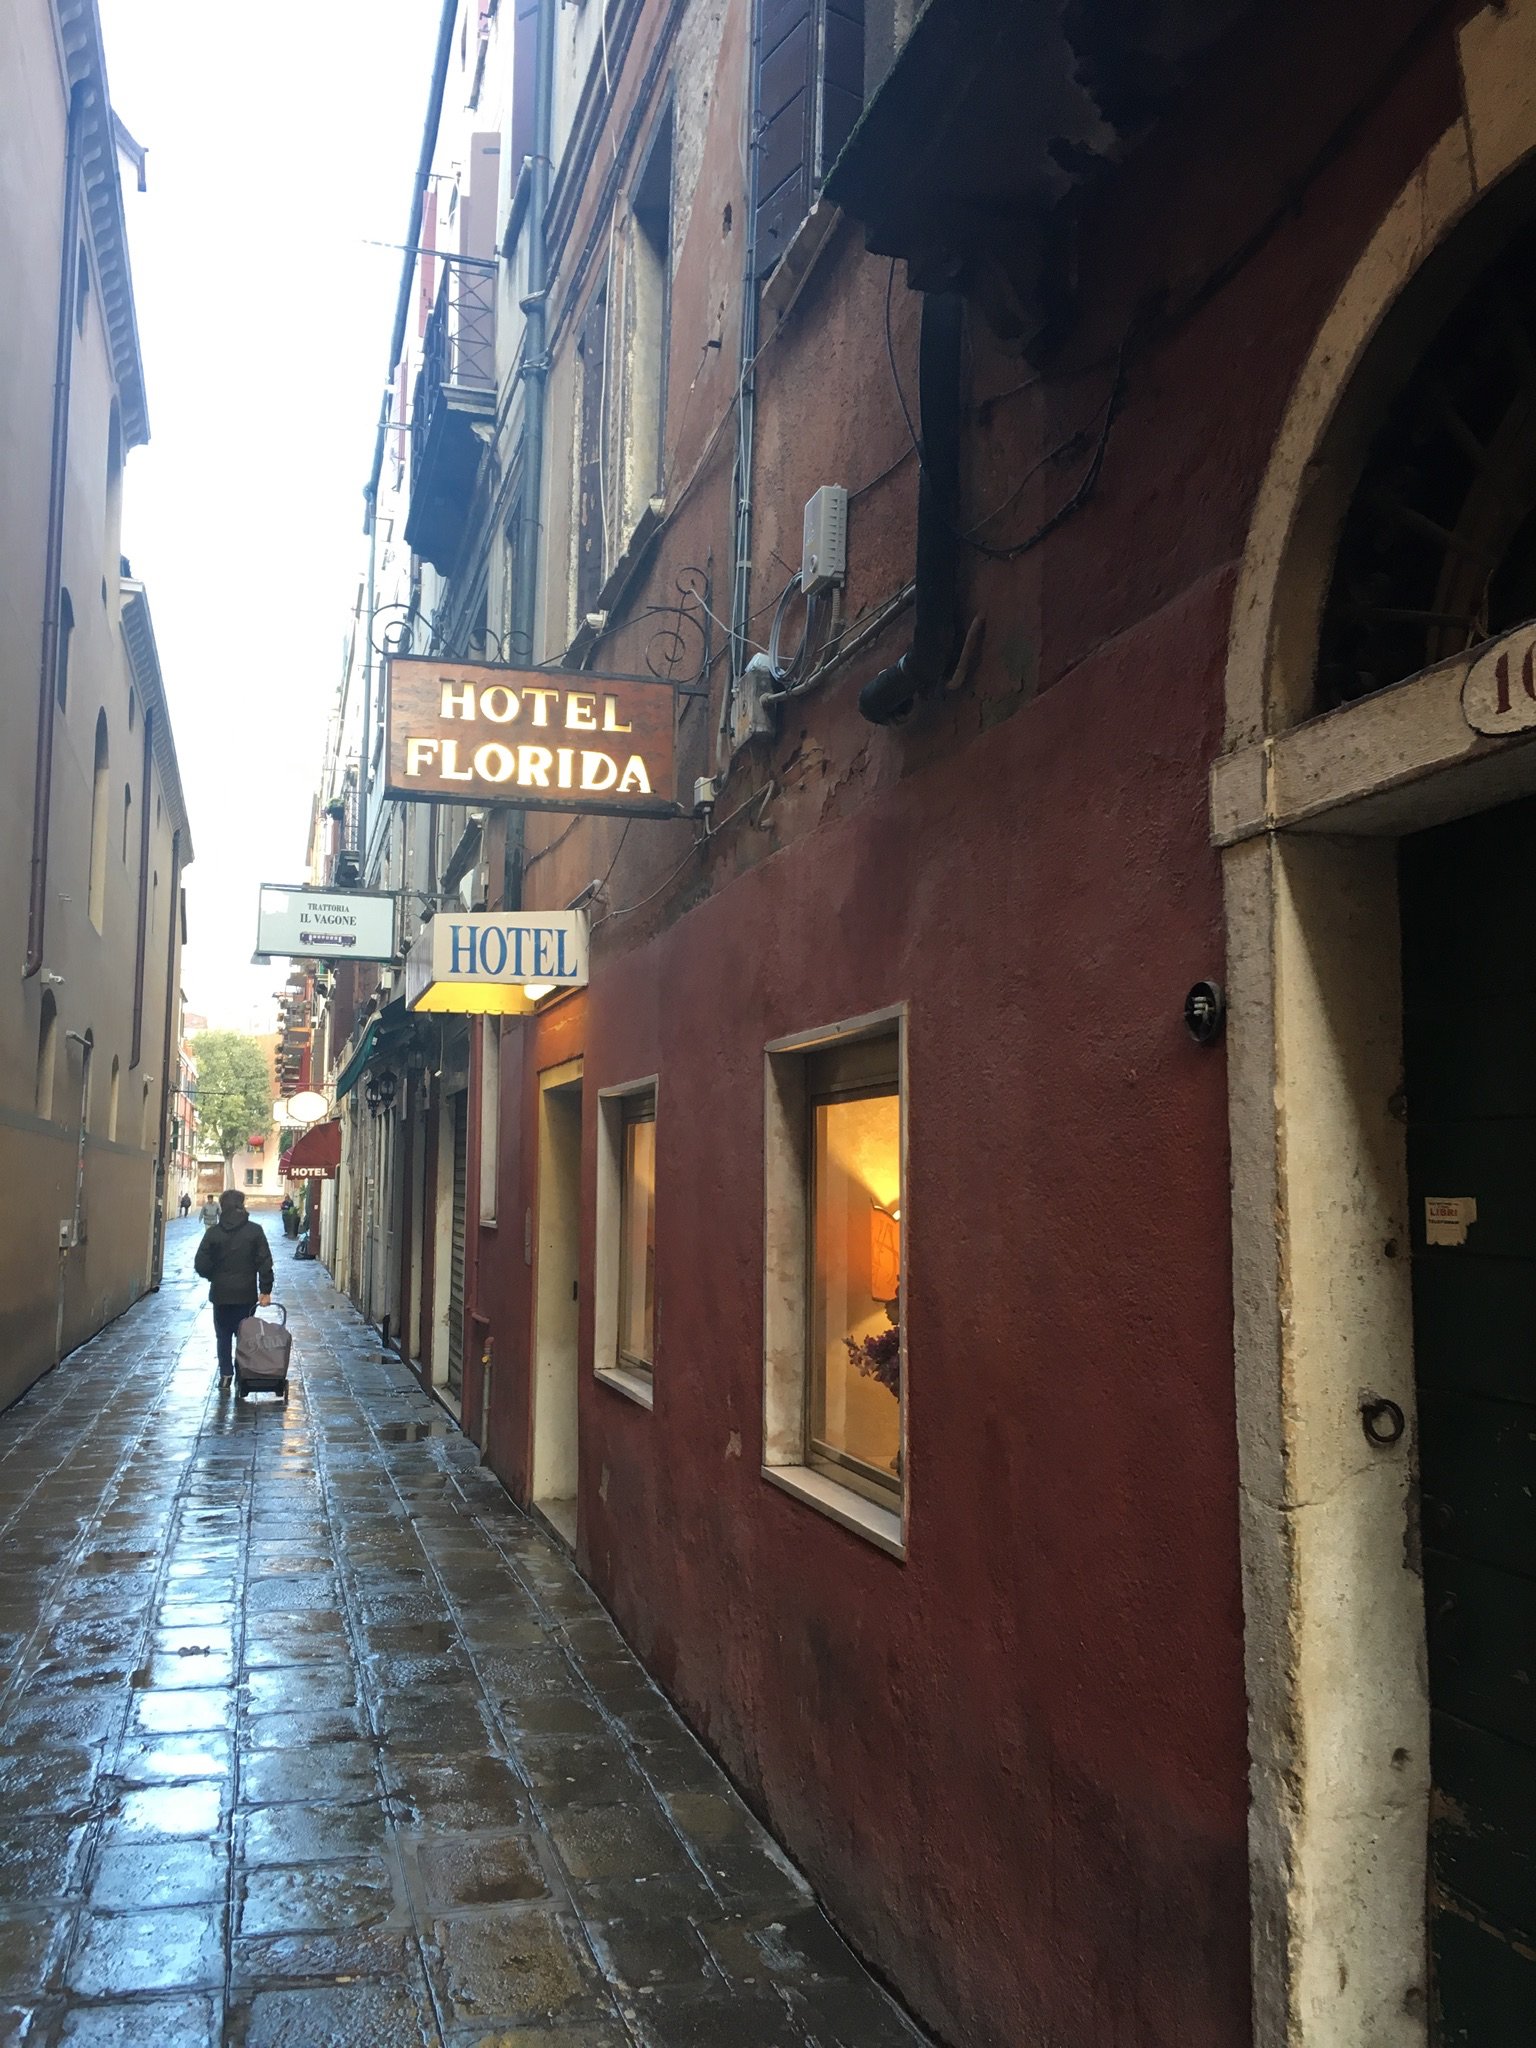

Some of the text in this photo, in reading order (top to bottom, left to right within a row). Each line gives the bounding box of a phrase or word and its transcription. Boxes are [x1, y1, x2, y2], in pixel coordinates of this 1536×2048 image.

[439, 679, 632, 732] HOTEL
[404, 737, 656, 794] FLORIDA
[308, 903, 349, 912] TRATTORIA
[300, 913, 357, 926] IL VAGONE
[449, 925, 578, 977] HOTEL
[291, 1167, 328, 1176] HOTEL
[1430, 1208, 1458, 1216] LIBRI
